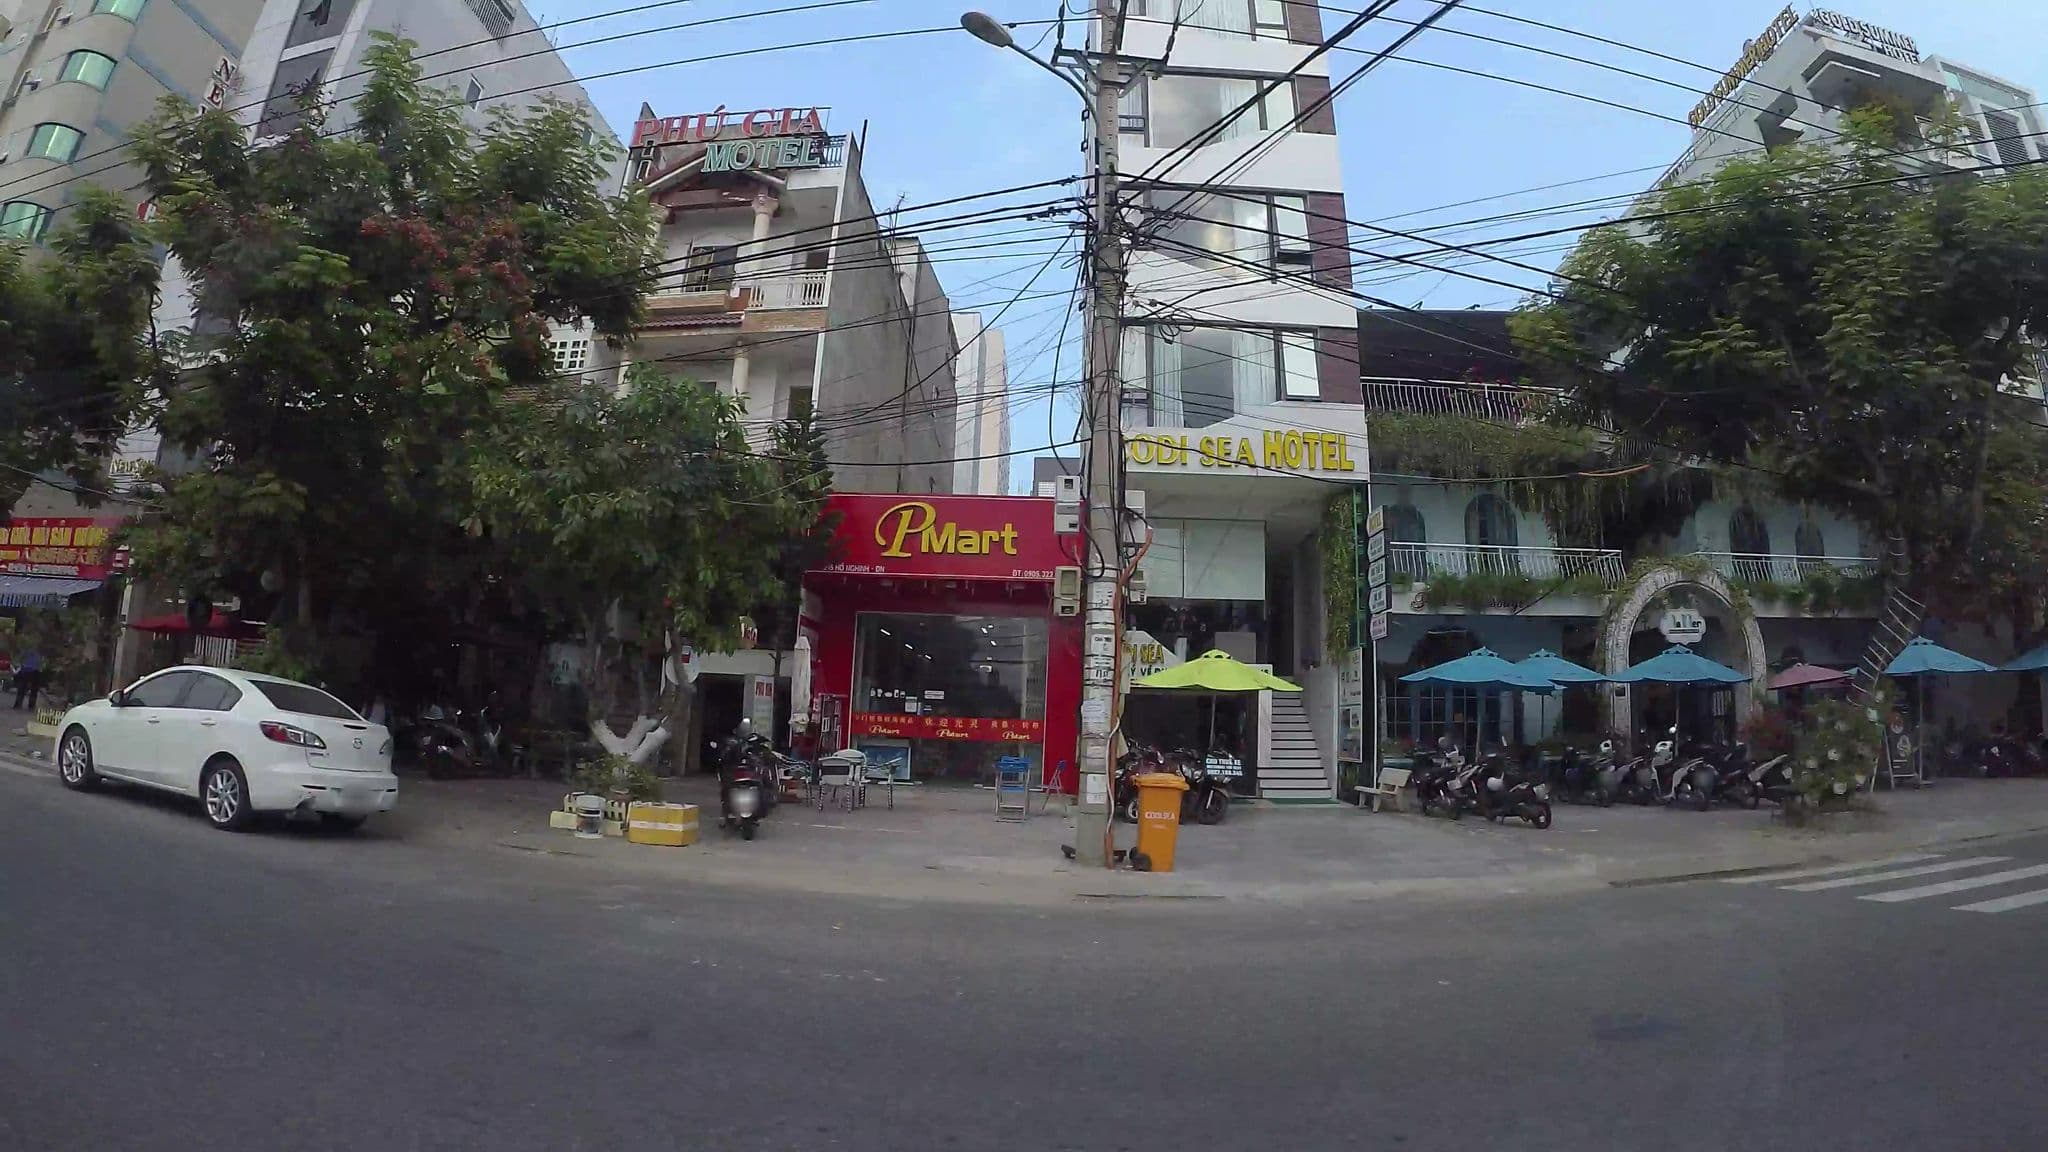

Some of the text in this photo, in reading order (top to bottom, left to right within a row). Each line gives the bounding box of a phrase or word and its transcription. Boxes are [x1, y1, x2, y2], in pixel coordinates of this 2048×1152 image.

[631, 104, 824, 148] PHÚ GIA
[701, 137, 820, 173] MOTEL
[1126, 429, 1356, 472] ODI SEA HOTEL
[874, 501, 1018, 558] PMart
